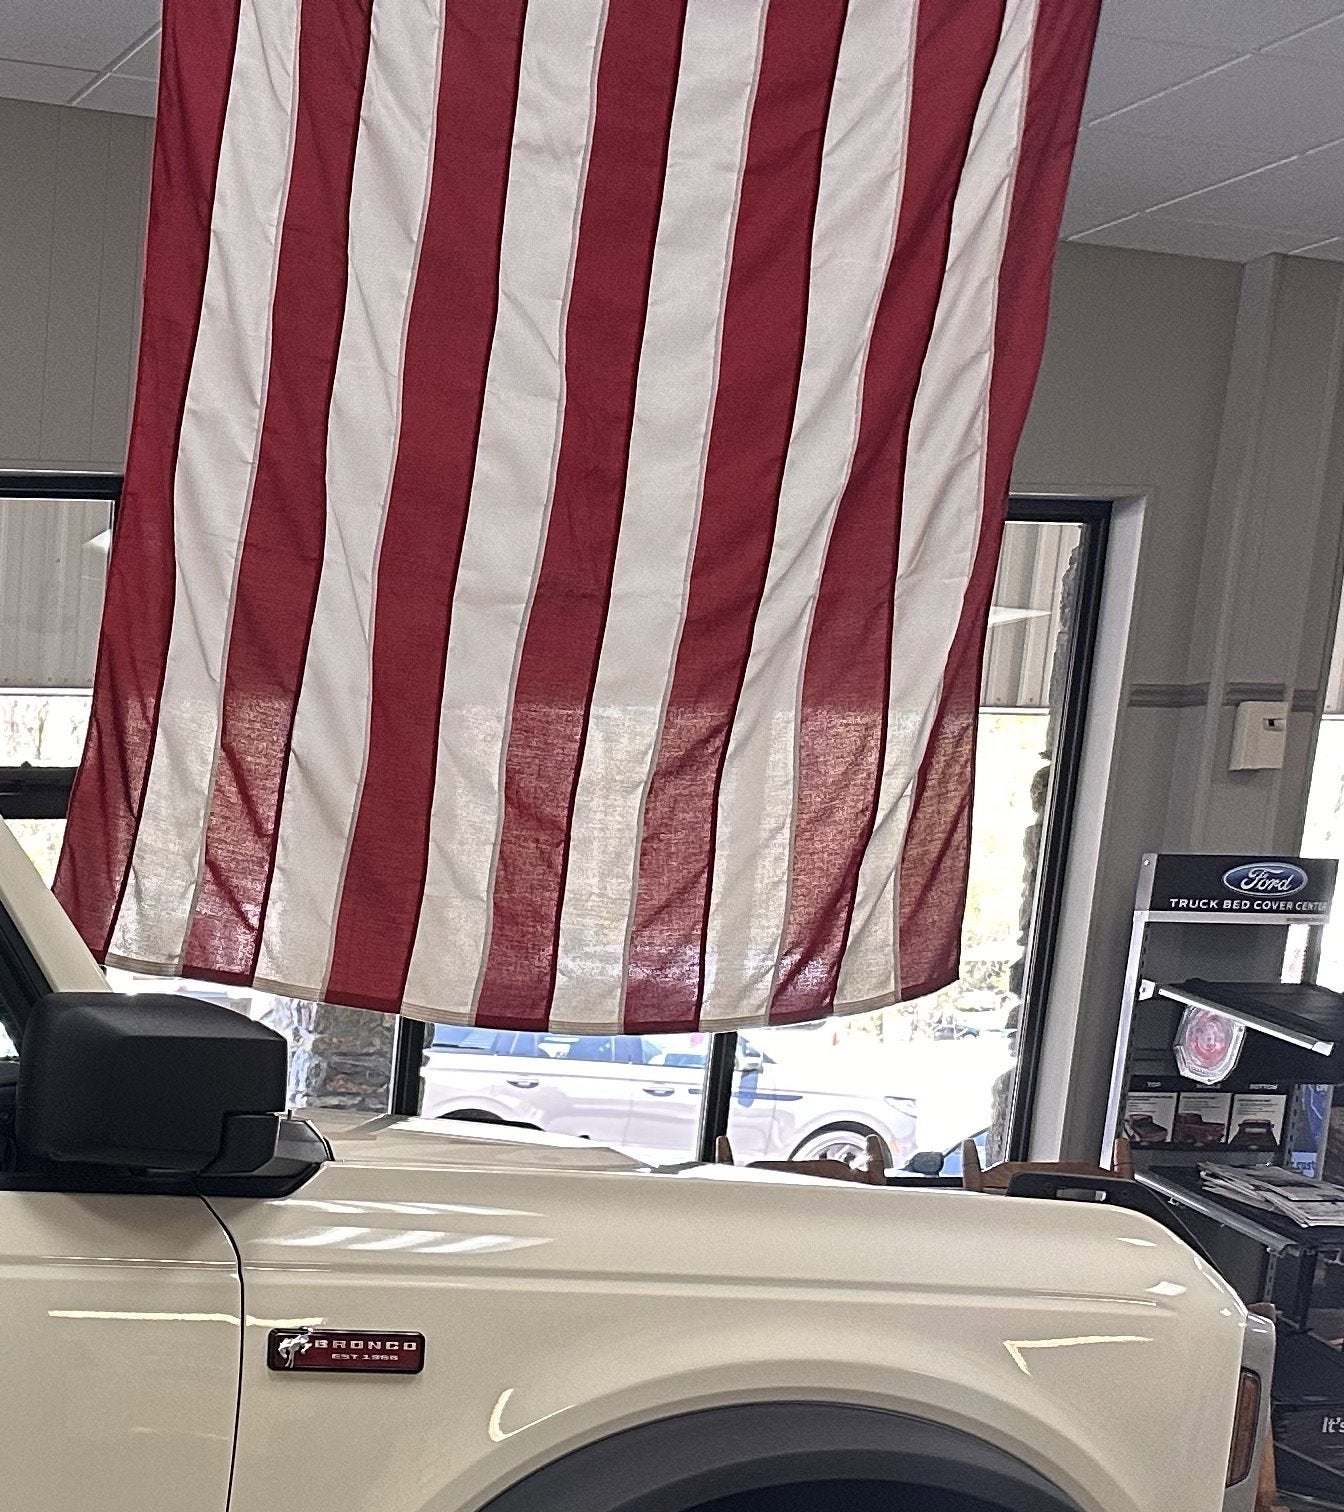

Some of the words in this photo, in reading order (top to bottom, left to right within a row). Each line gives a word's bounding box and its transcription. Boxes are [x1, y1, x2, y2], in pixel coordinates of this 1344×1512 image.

[1240, 867, 1294, 892] Ford
[1170, 898, 1219, 909] TRUCK
[1222, 899, 1251, 910] BED
[1253, 900, 1293, 911] COVER
[1295, 901, 1327, 912] CENTER
[314, 1339, 417, 1350] BRONCO
